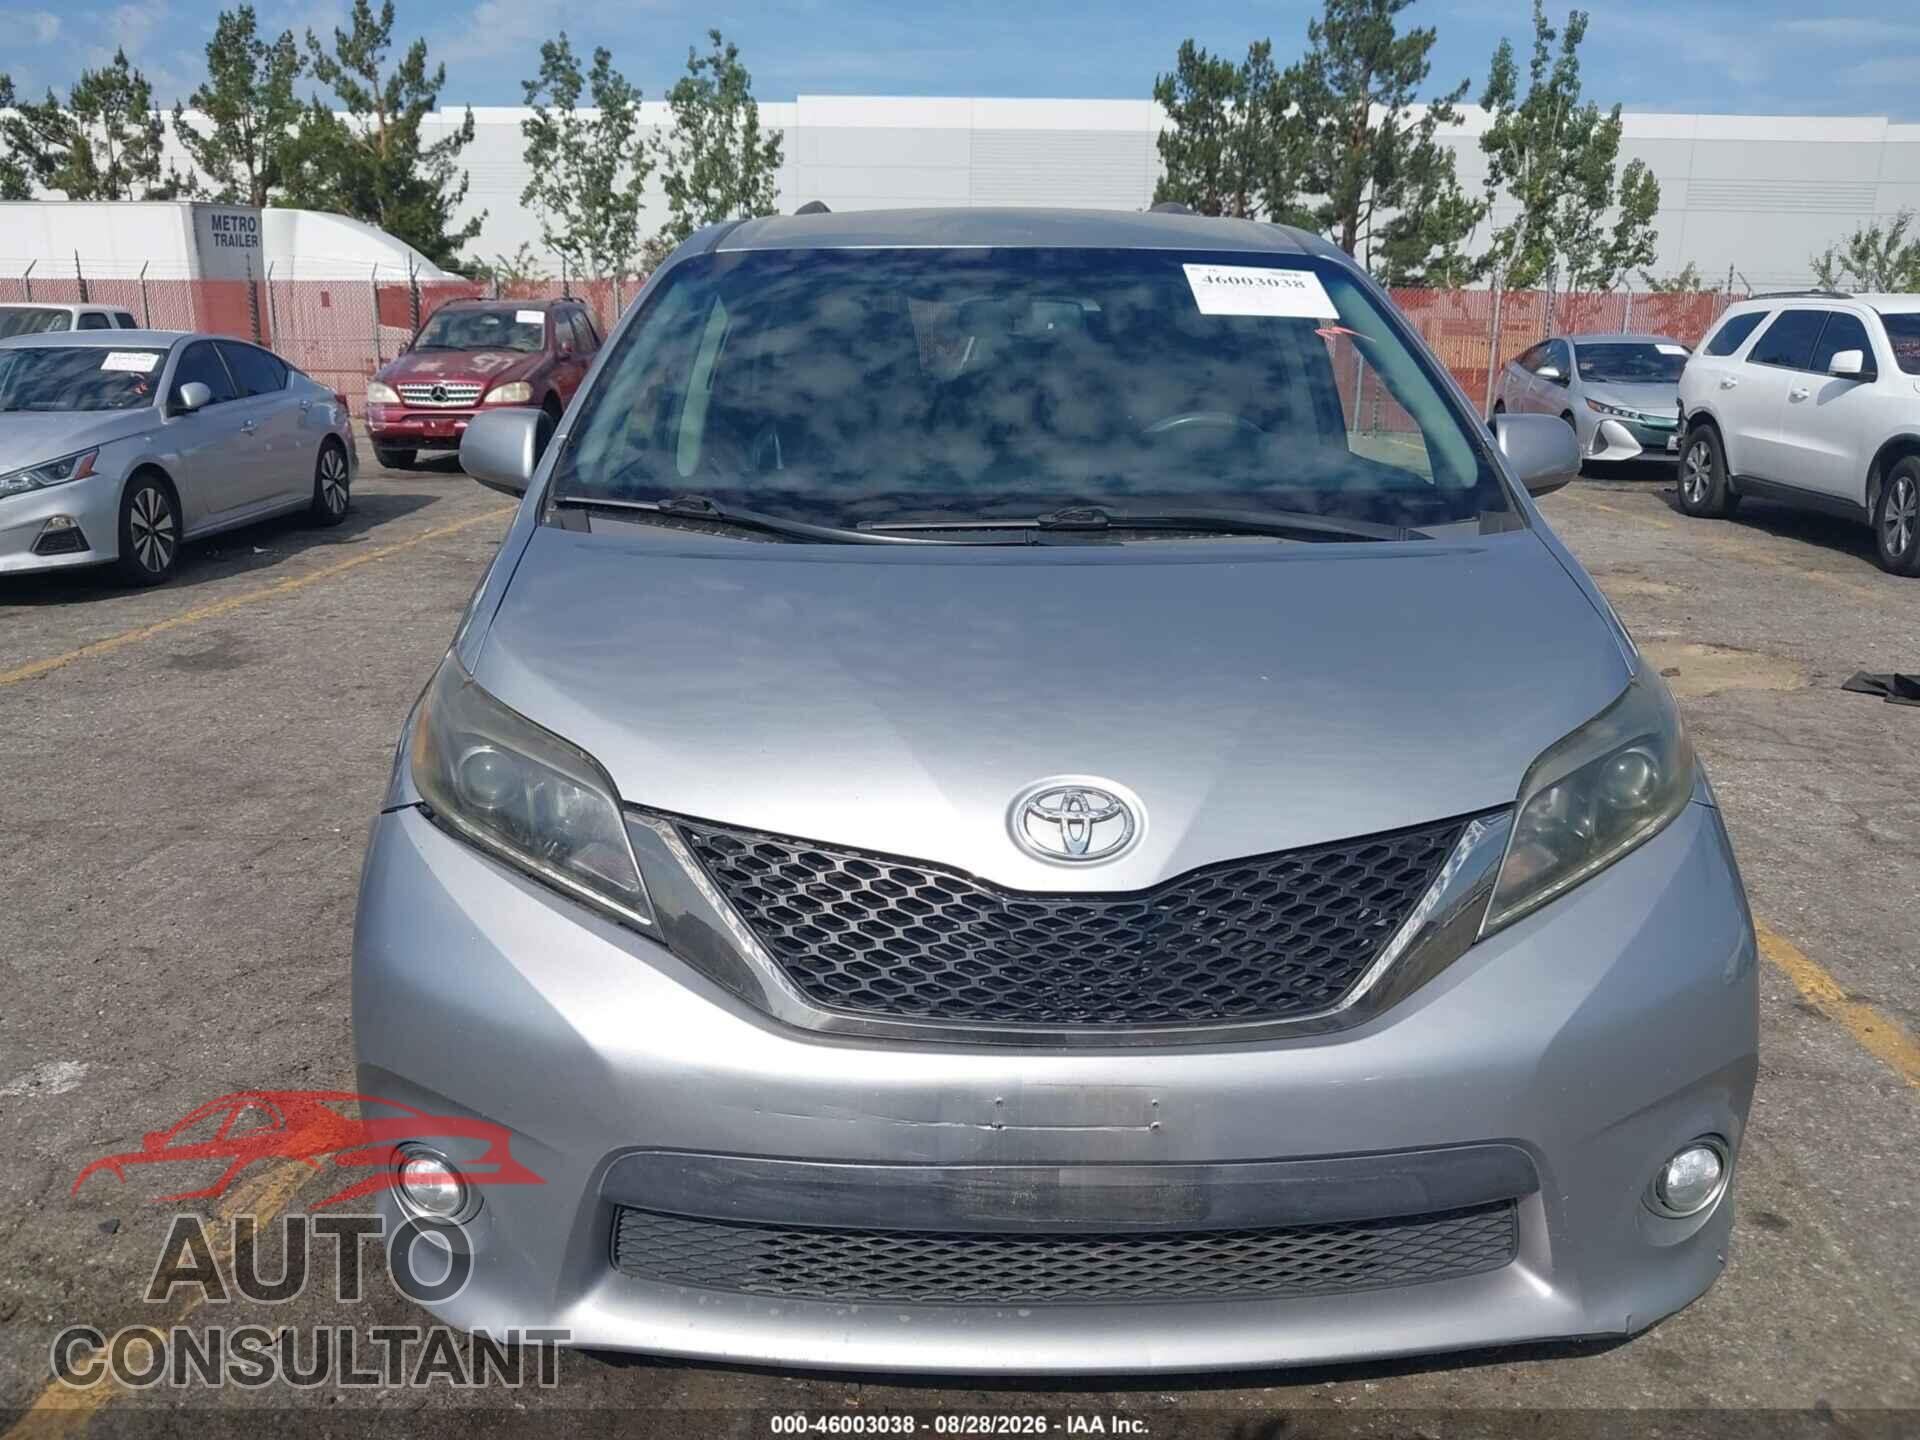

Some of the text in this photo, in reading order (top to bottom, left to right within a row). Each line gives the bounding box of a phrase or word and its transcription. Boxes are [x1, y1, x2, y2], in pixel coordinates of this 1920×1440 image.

[211, 214, 256, 232] METRO
[213, 233, 258, 248] TRAILER
[1202, 275, 1306, 289] 46003038
